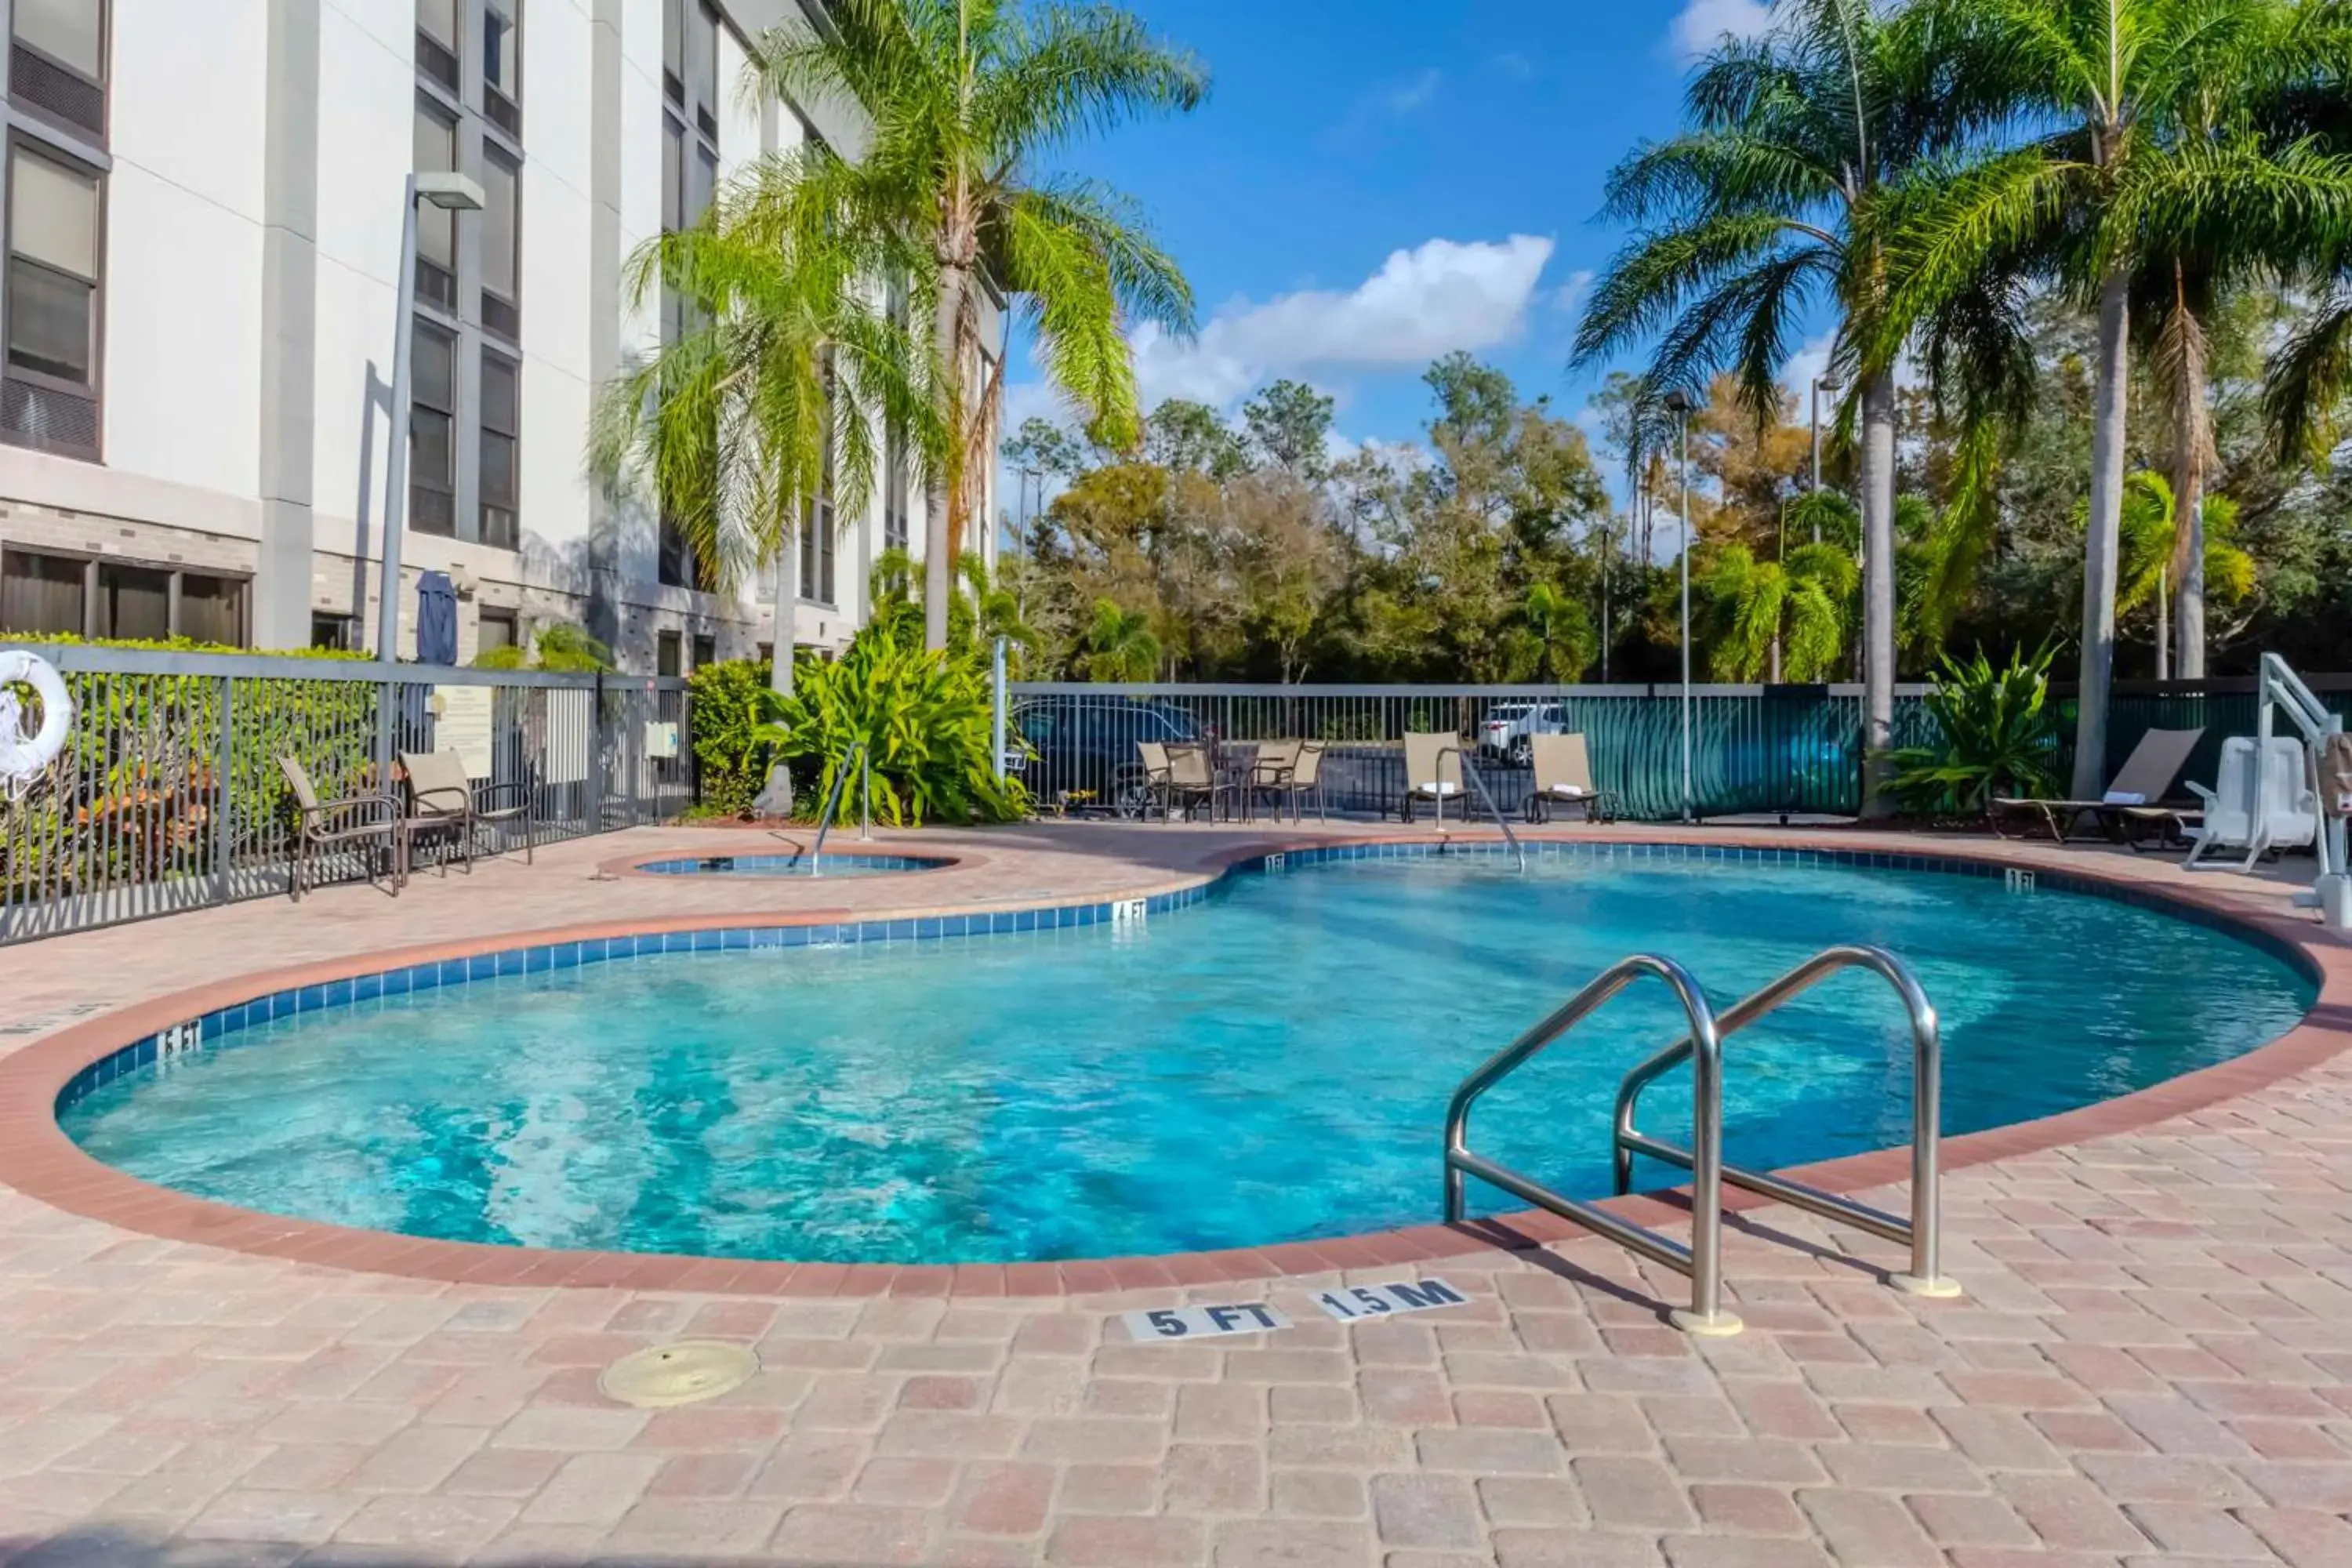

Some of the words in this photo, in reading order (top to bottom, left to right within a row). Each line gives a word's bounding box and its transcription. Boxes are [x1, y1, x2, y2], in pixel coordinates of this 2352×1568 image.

[1118, 902, 1126, 921] 4
[1131, 901, 1144, 924] FT
[181, 1021, 200, 1051] FT
[1146, 1310, 1188, 1337] 5
[1203, 1303, 1277, 1331] FT
[1385, 1279, 1466, 1308] M
